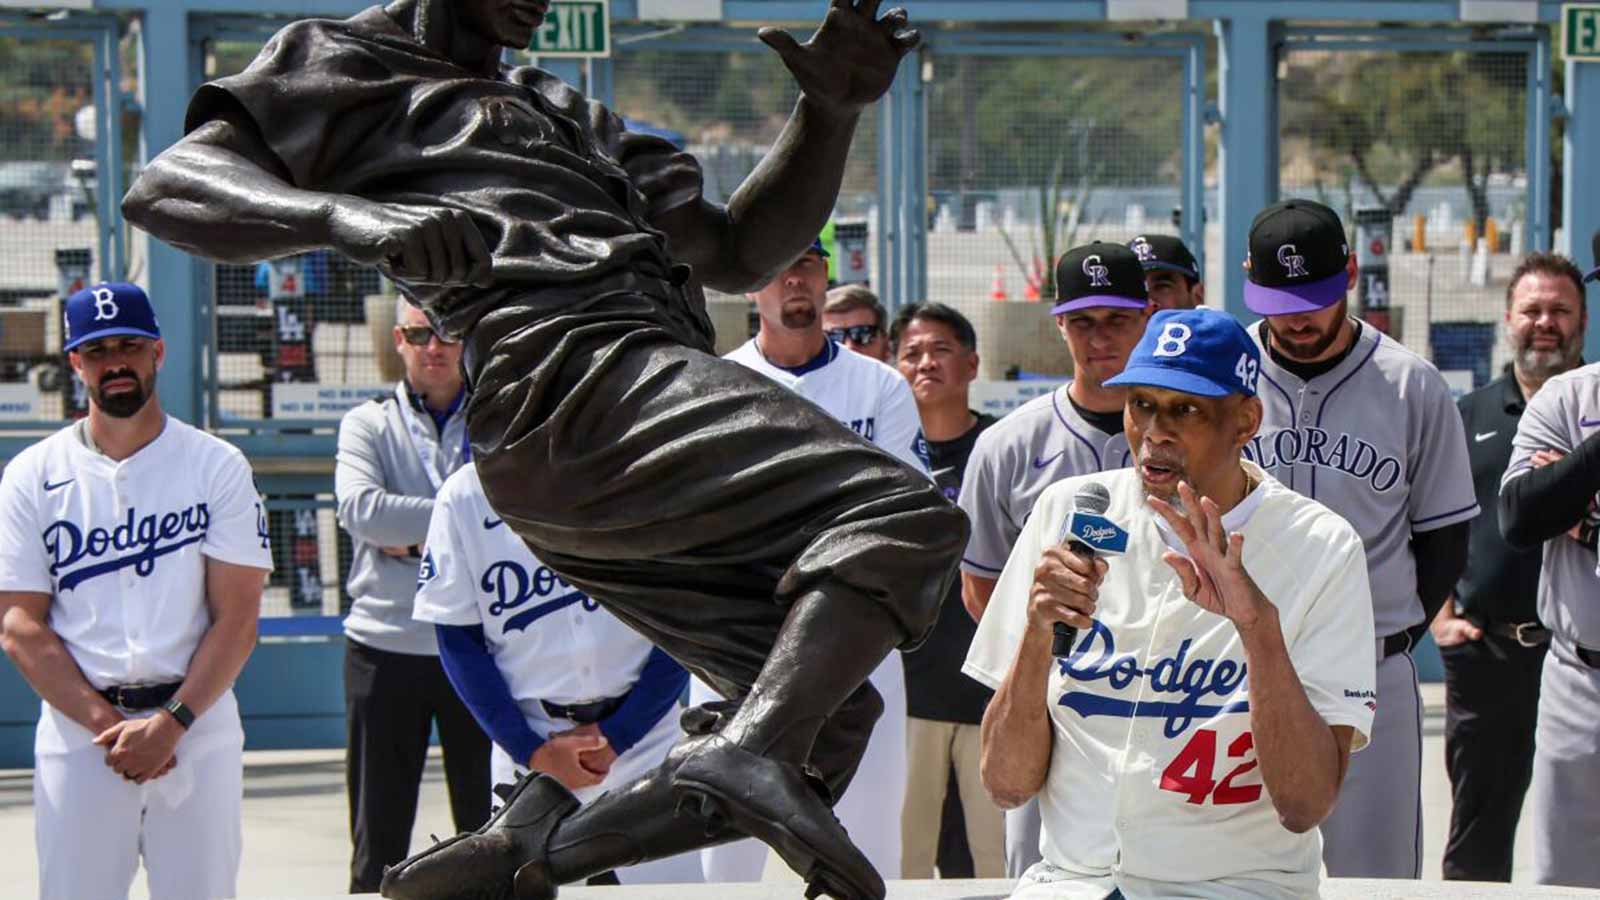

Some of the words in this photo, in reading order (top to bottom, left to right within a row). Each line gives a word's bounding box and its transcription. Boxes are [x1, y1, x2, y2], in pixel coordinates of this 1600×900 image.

[538, 4, 597, 49] EXIT
[1082, 254, 1112, 287] CR
[1277, 244, 1310, 278] CR
[91, 287, 119, 321] B
[1152, 322, 1192, 357] B
[1235, 352, 1257, 393] 42
[1241, 427, 1401, 492] LORADO
[43, 502, 209, 577] Dodgers
[1159, 729, 1263, 805] 42
